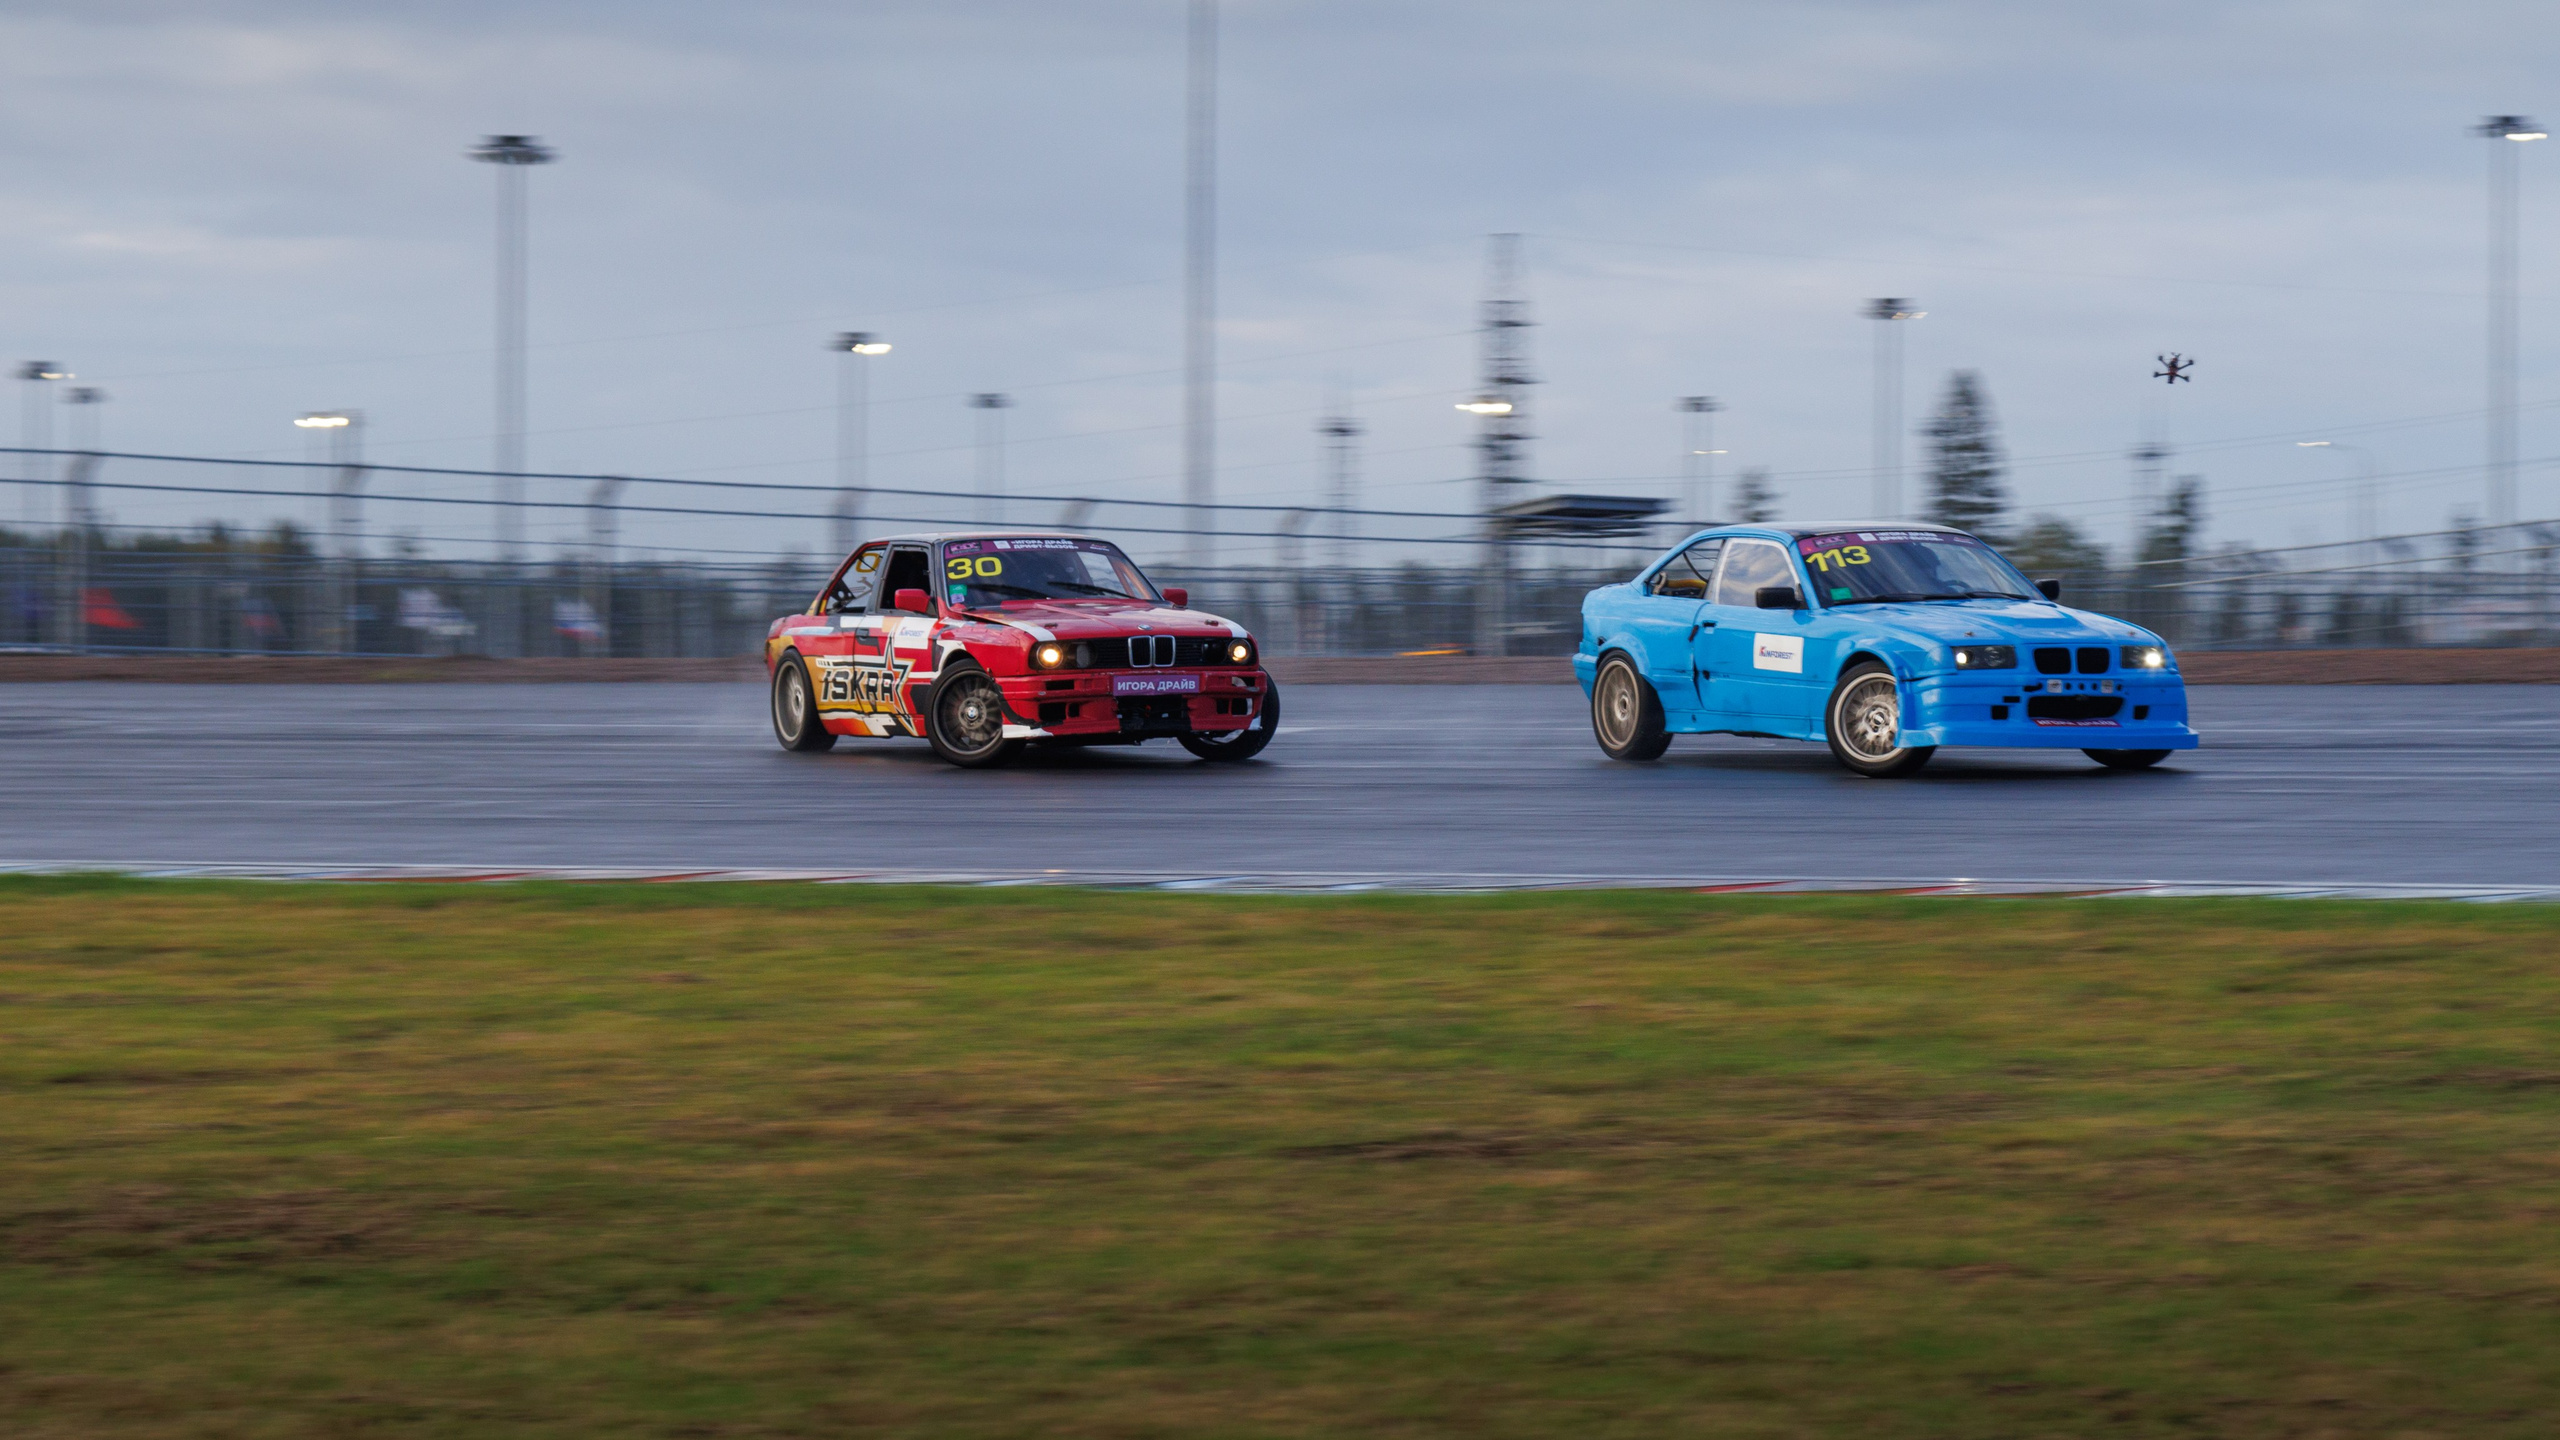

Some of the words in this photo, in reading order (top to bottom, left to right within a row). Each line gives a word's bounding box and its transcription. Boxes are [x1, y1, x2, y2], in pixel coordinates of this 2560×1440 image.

[947, 557, 1003, 580] 30
[1806, 546, 1871, 572] 113
[1117, 681, 1155, 691] ИГОРА
[1157, 679, 1196, 691] ДРАЙВ
